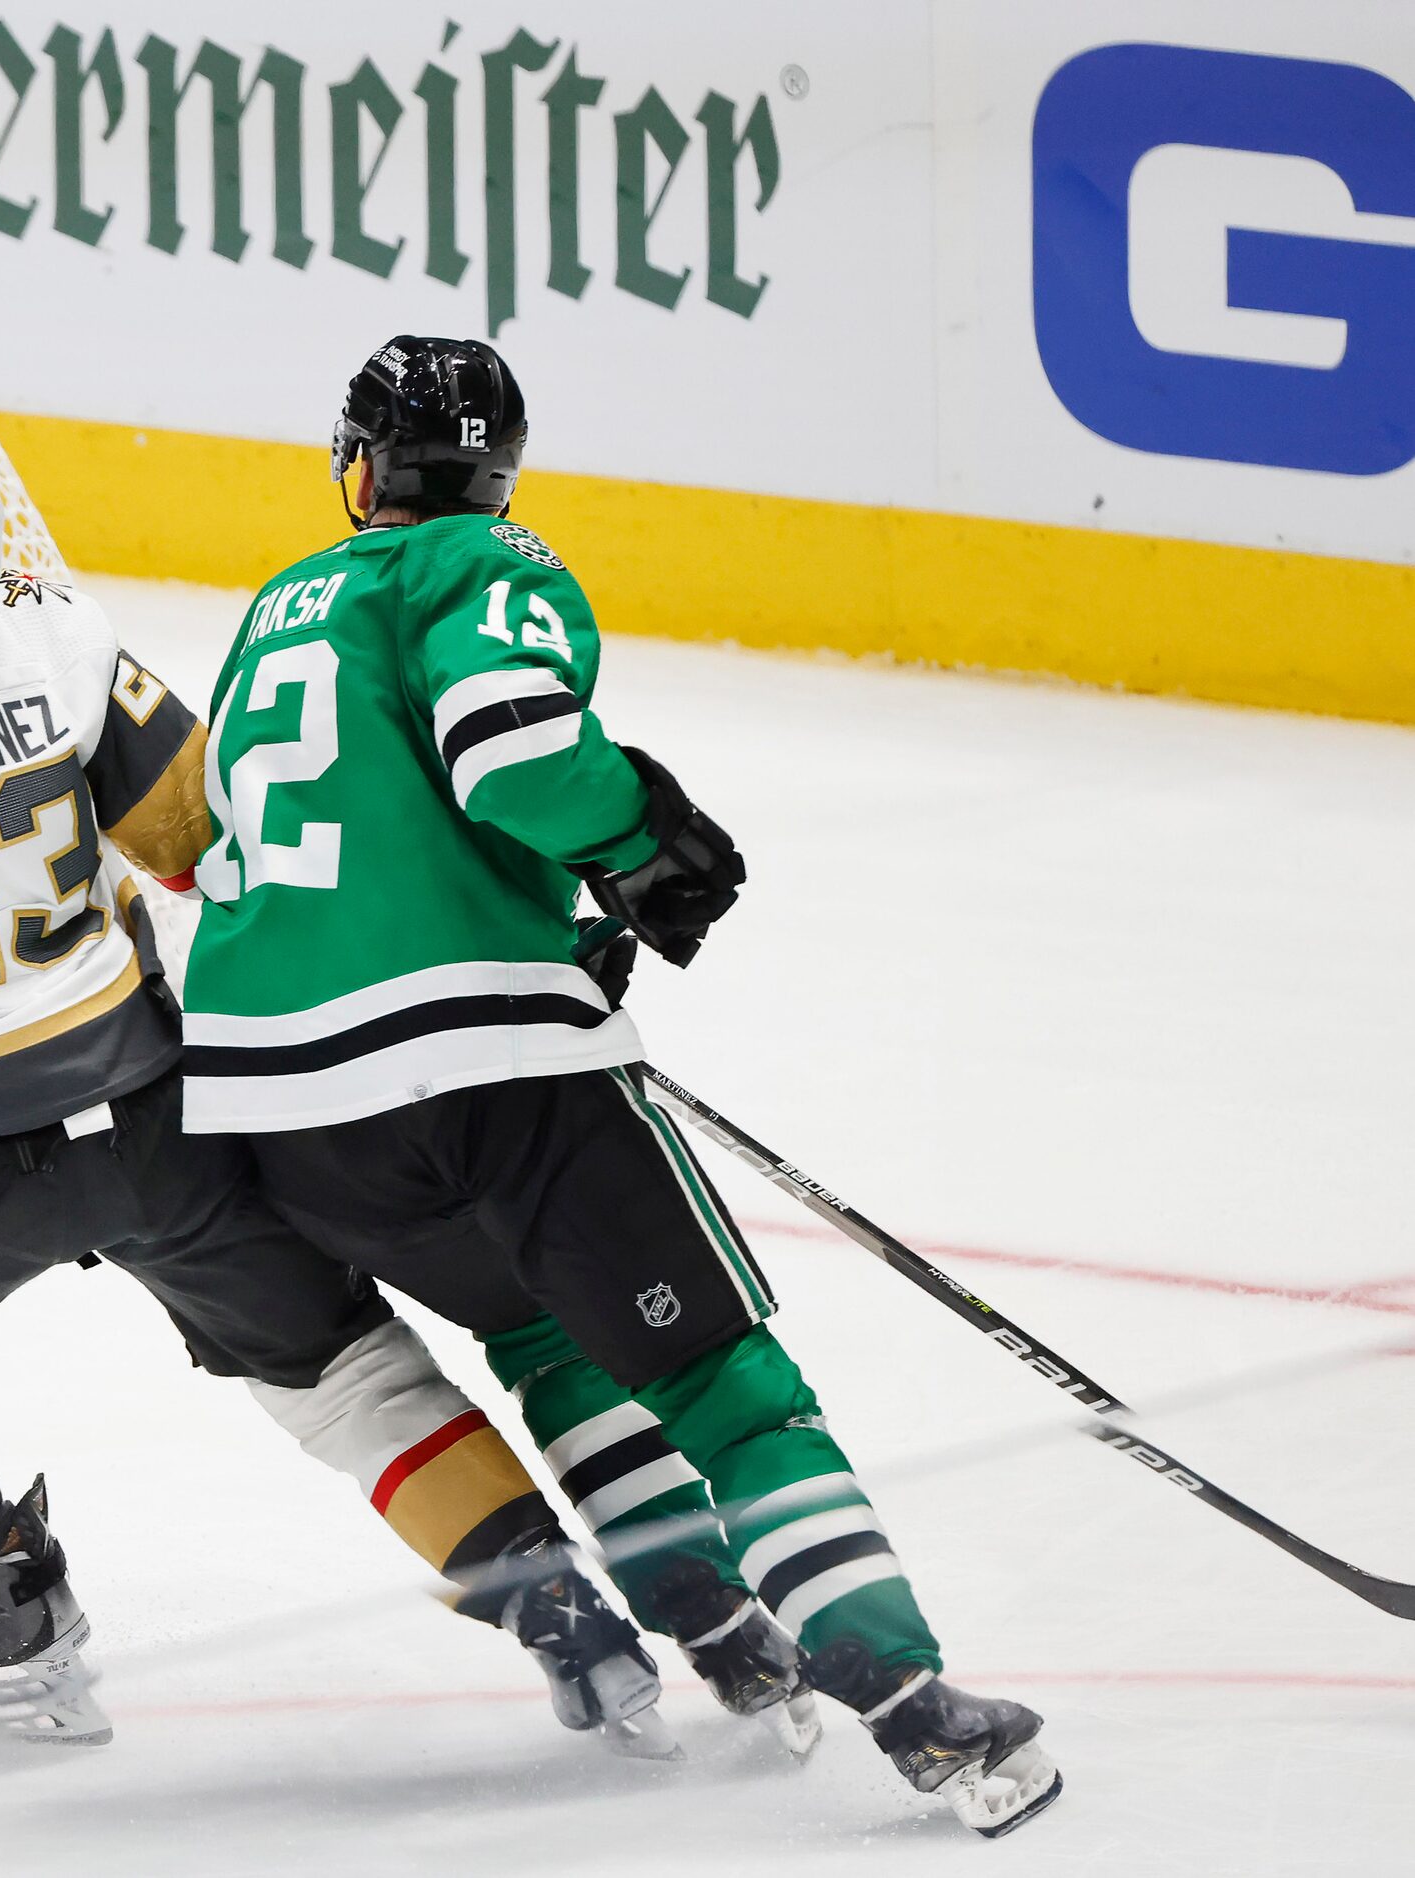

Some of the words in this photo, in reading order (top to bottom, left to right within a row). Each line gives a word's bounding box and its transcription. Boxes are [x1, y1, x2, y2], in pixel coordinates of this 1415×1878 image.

[459, 417, 487, 449] 12
[477, 580, 573, 664] 12
[193, 638, 342, 903] 12
[652, 1071, 698, 1106] MARTINEZ
[927, 1267, 993, 1314] HYPERLITE
